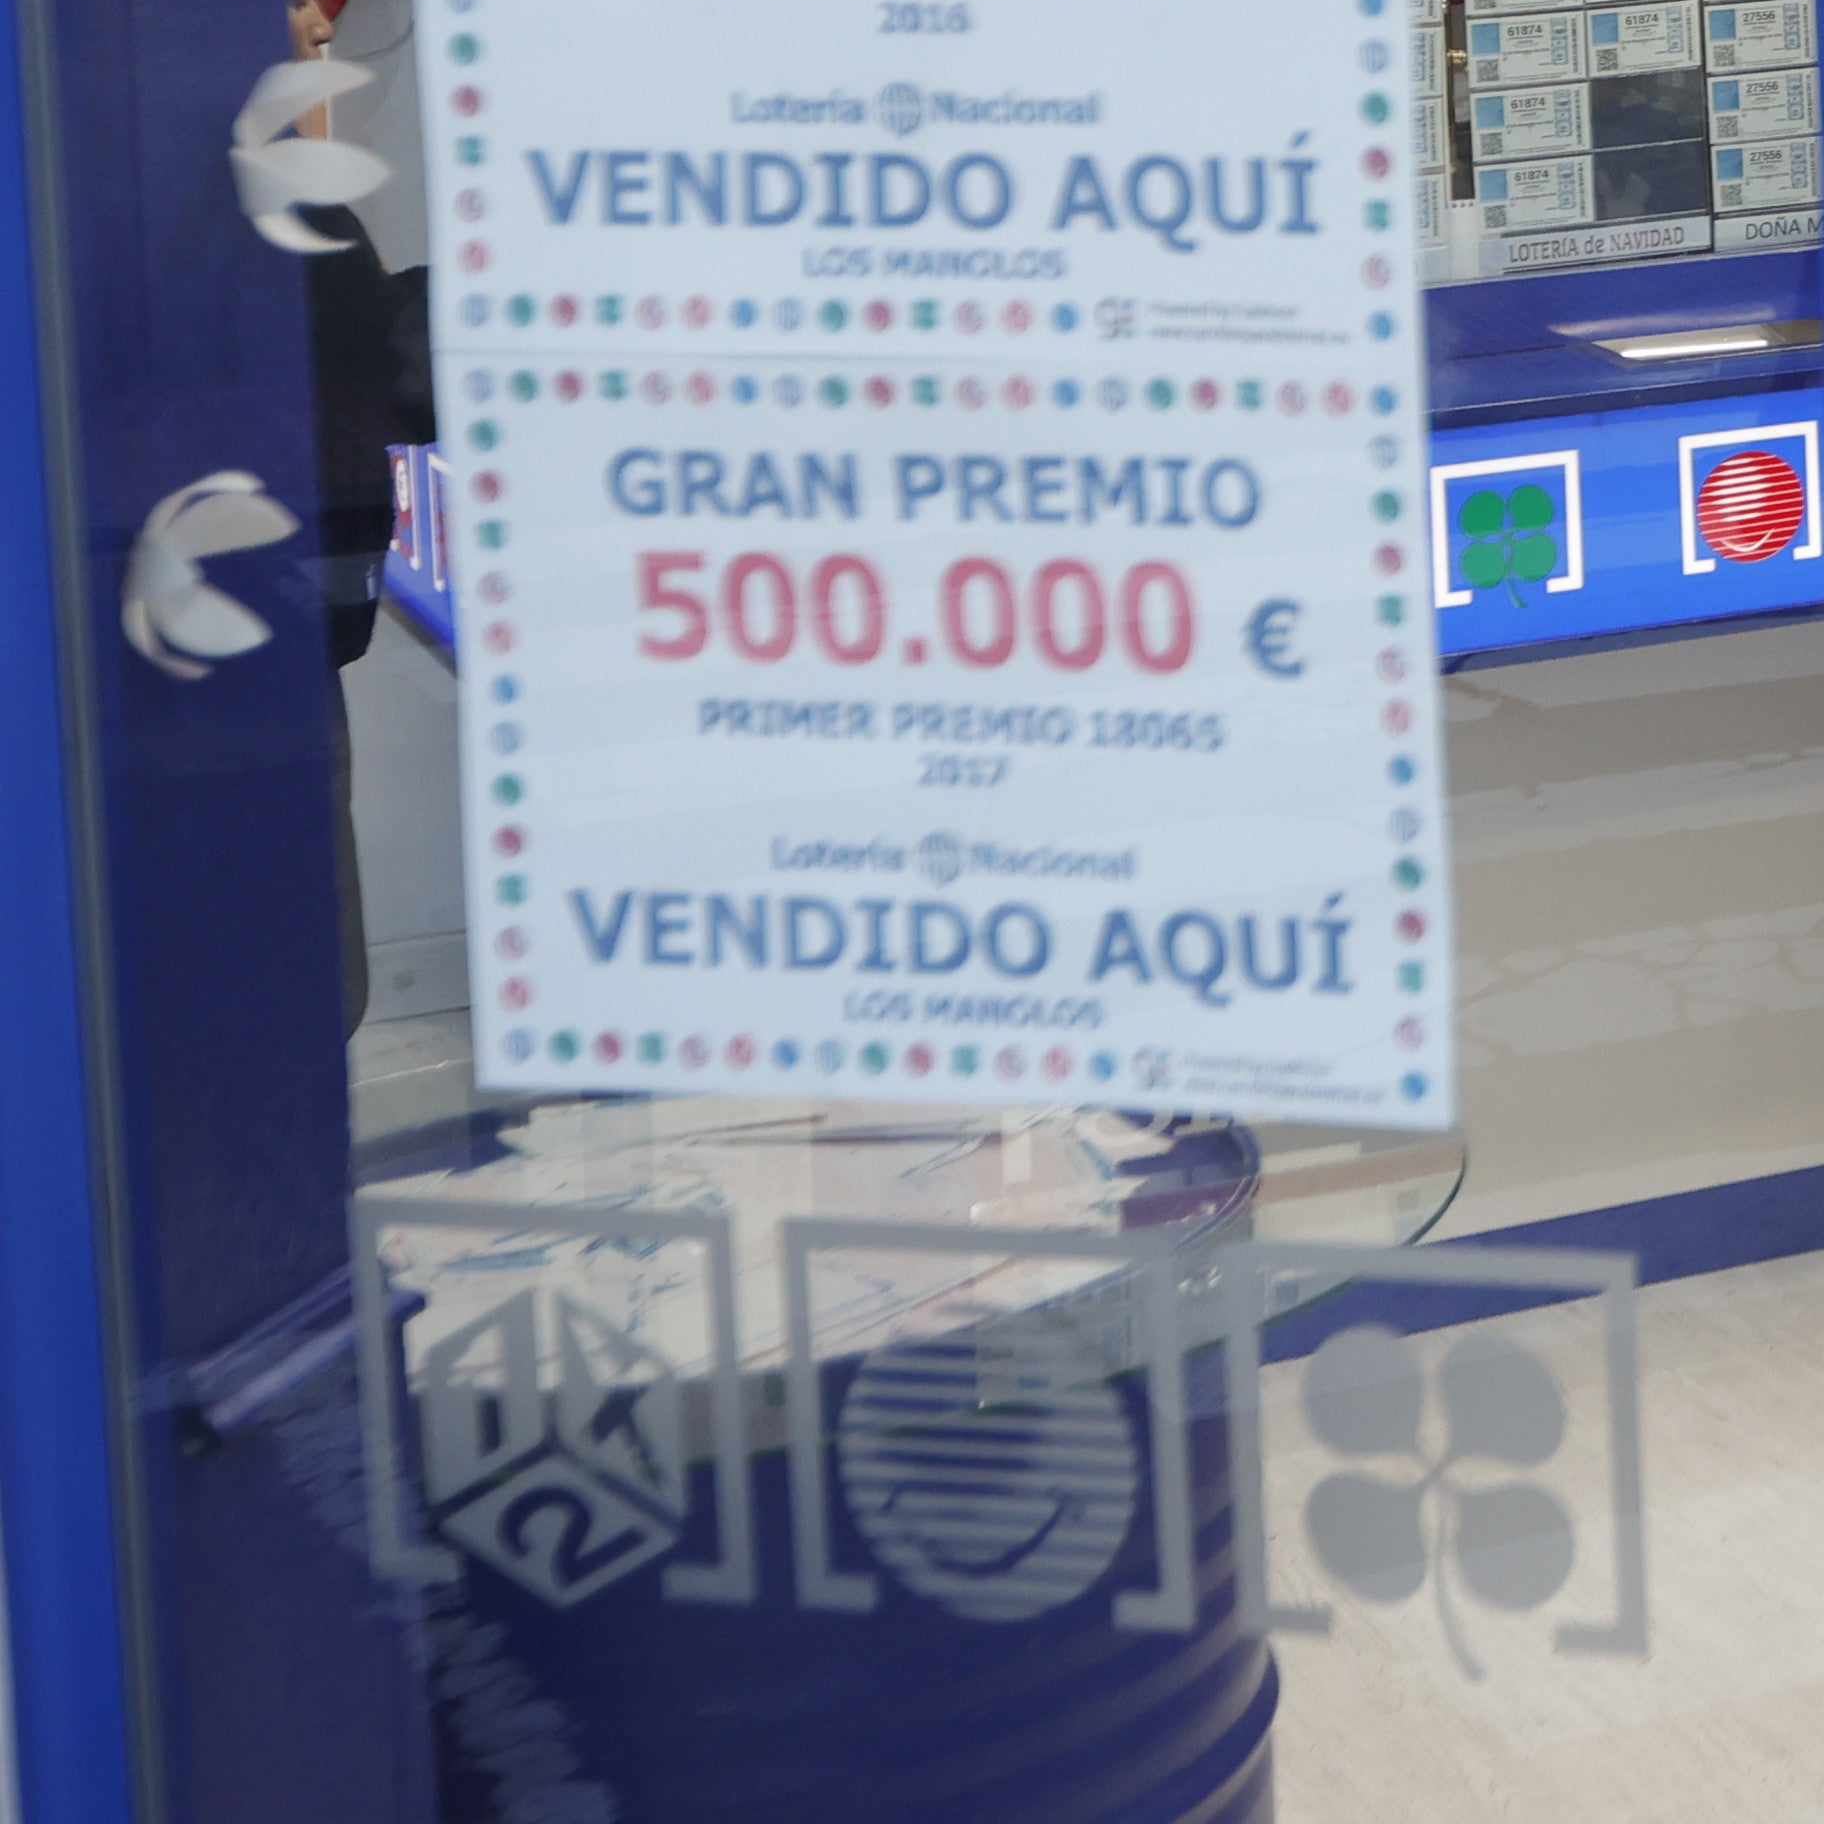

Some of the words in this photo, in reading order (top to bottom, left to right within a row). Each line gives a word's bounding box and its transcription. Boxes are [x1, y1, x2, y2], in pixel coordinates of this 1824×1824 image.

[1506, 24, 1543, 37] 61874
[526, 150, 1014, 232] VENDIDO
[1054, 132, 1323, 253] AQUÍ
[1745, 215, 1800, 241] DOÑA
[1509, 234, 1579, 263] LOTERÍA
[1584, 231, 1604, 253] de
[1610, 226, 1684, 252] NAVIDAD
[607, 447, 861, 523] GRAN
[896, 453, 1263, 531] PREMIO
[635, 549, 1198, 675] 500.000
[1243, 599, 1308, 678] €
[568, 887, 1052, 980] VENDIDO
[1089, 890, 1355, 1009] AQUÍ
